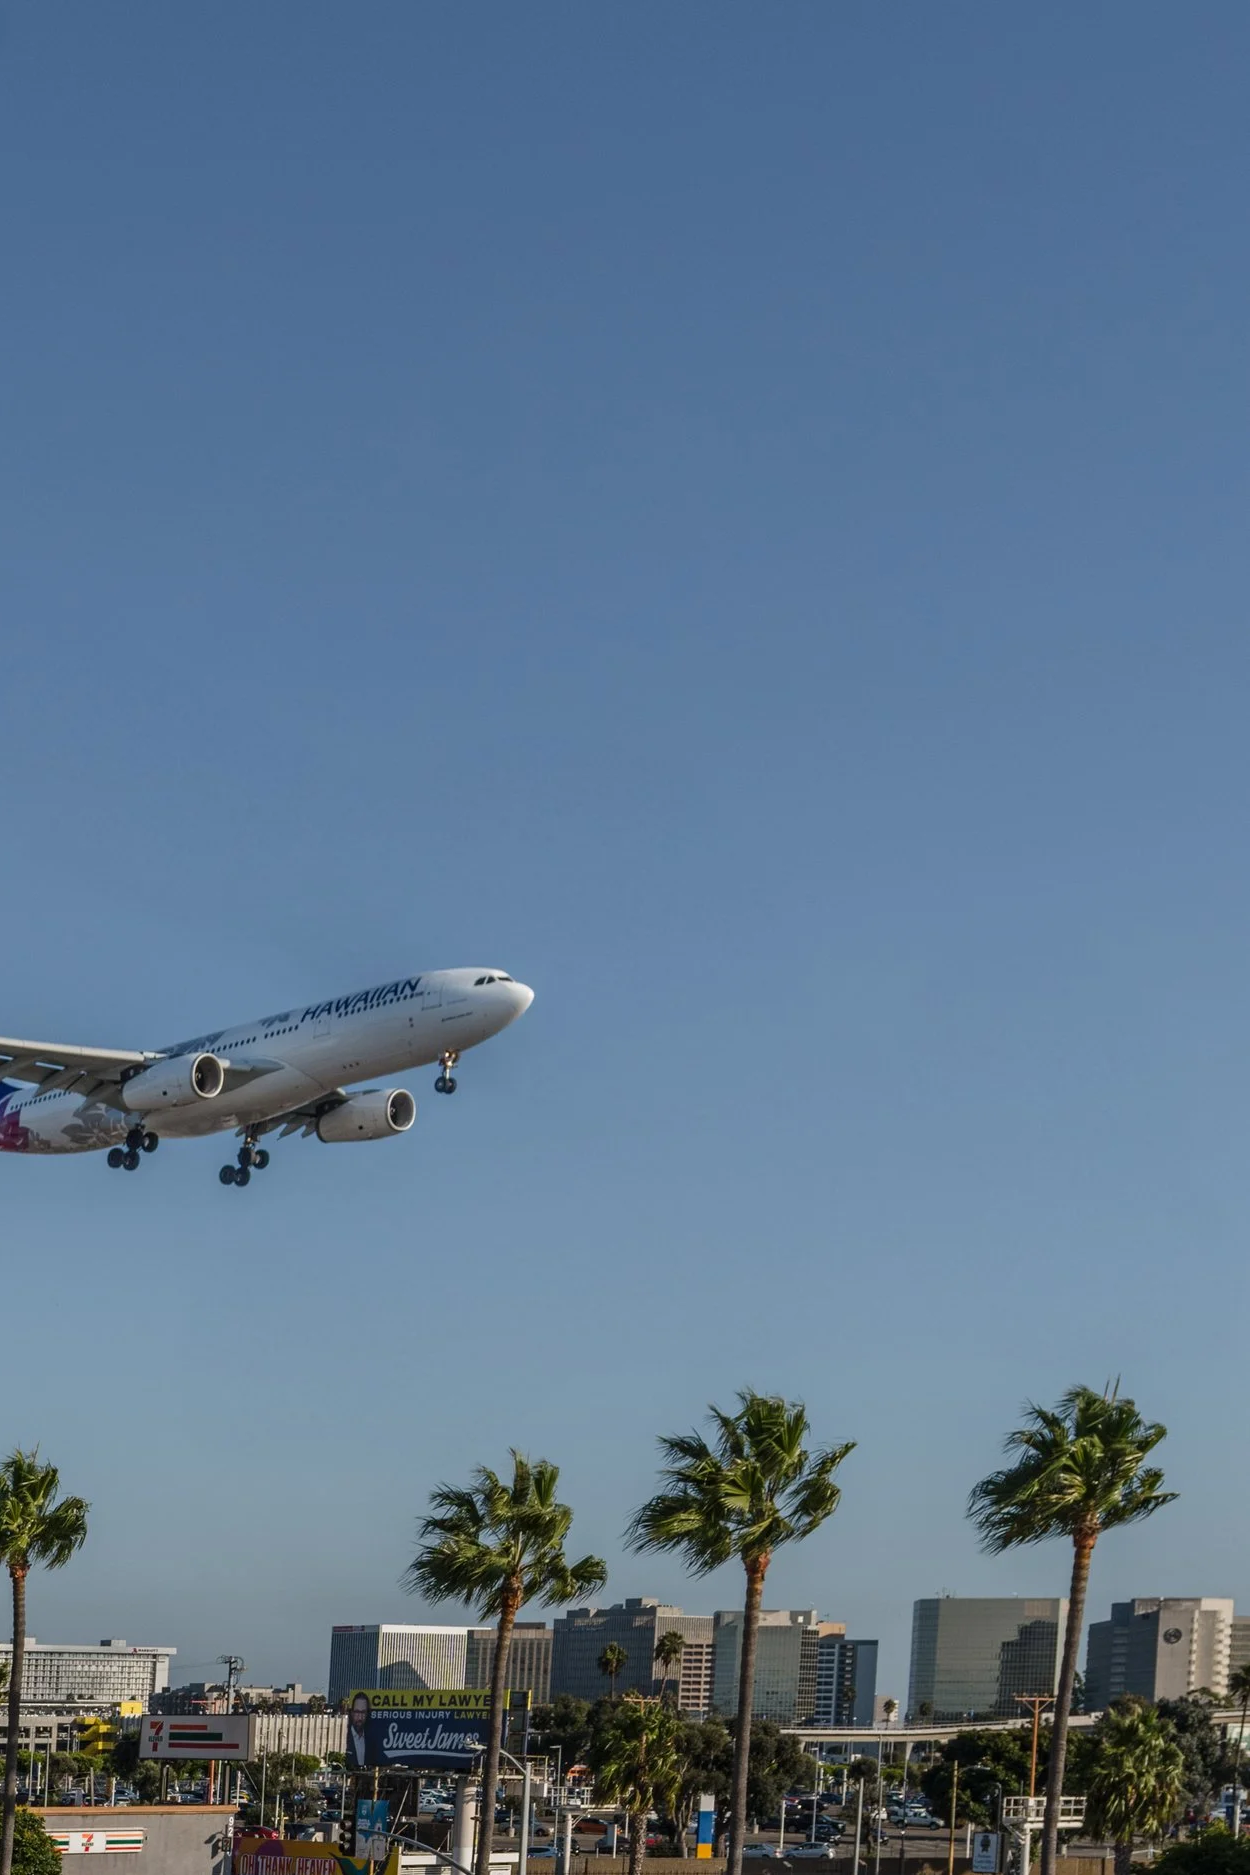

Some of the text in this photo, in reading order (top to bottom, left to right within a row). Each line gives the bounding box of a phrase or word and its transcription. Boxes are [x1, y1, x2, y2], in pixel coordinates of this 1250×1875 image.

[301, 977, 422, 1023] HAWAIIAN
[372, 1695, 491, 1707] CALL MY LAWYE
[371, 1711, 491, 1719] SERIOUS INJURY LAWYE
